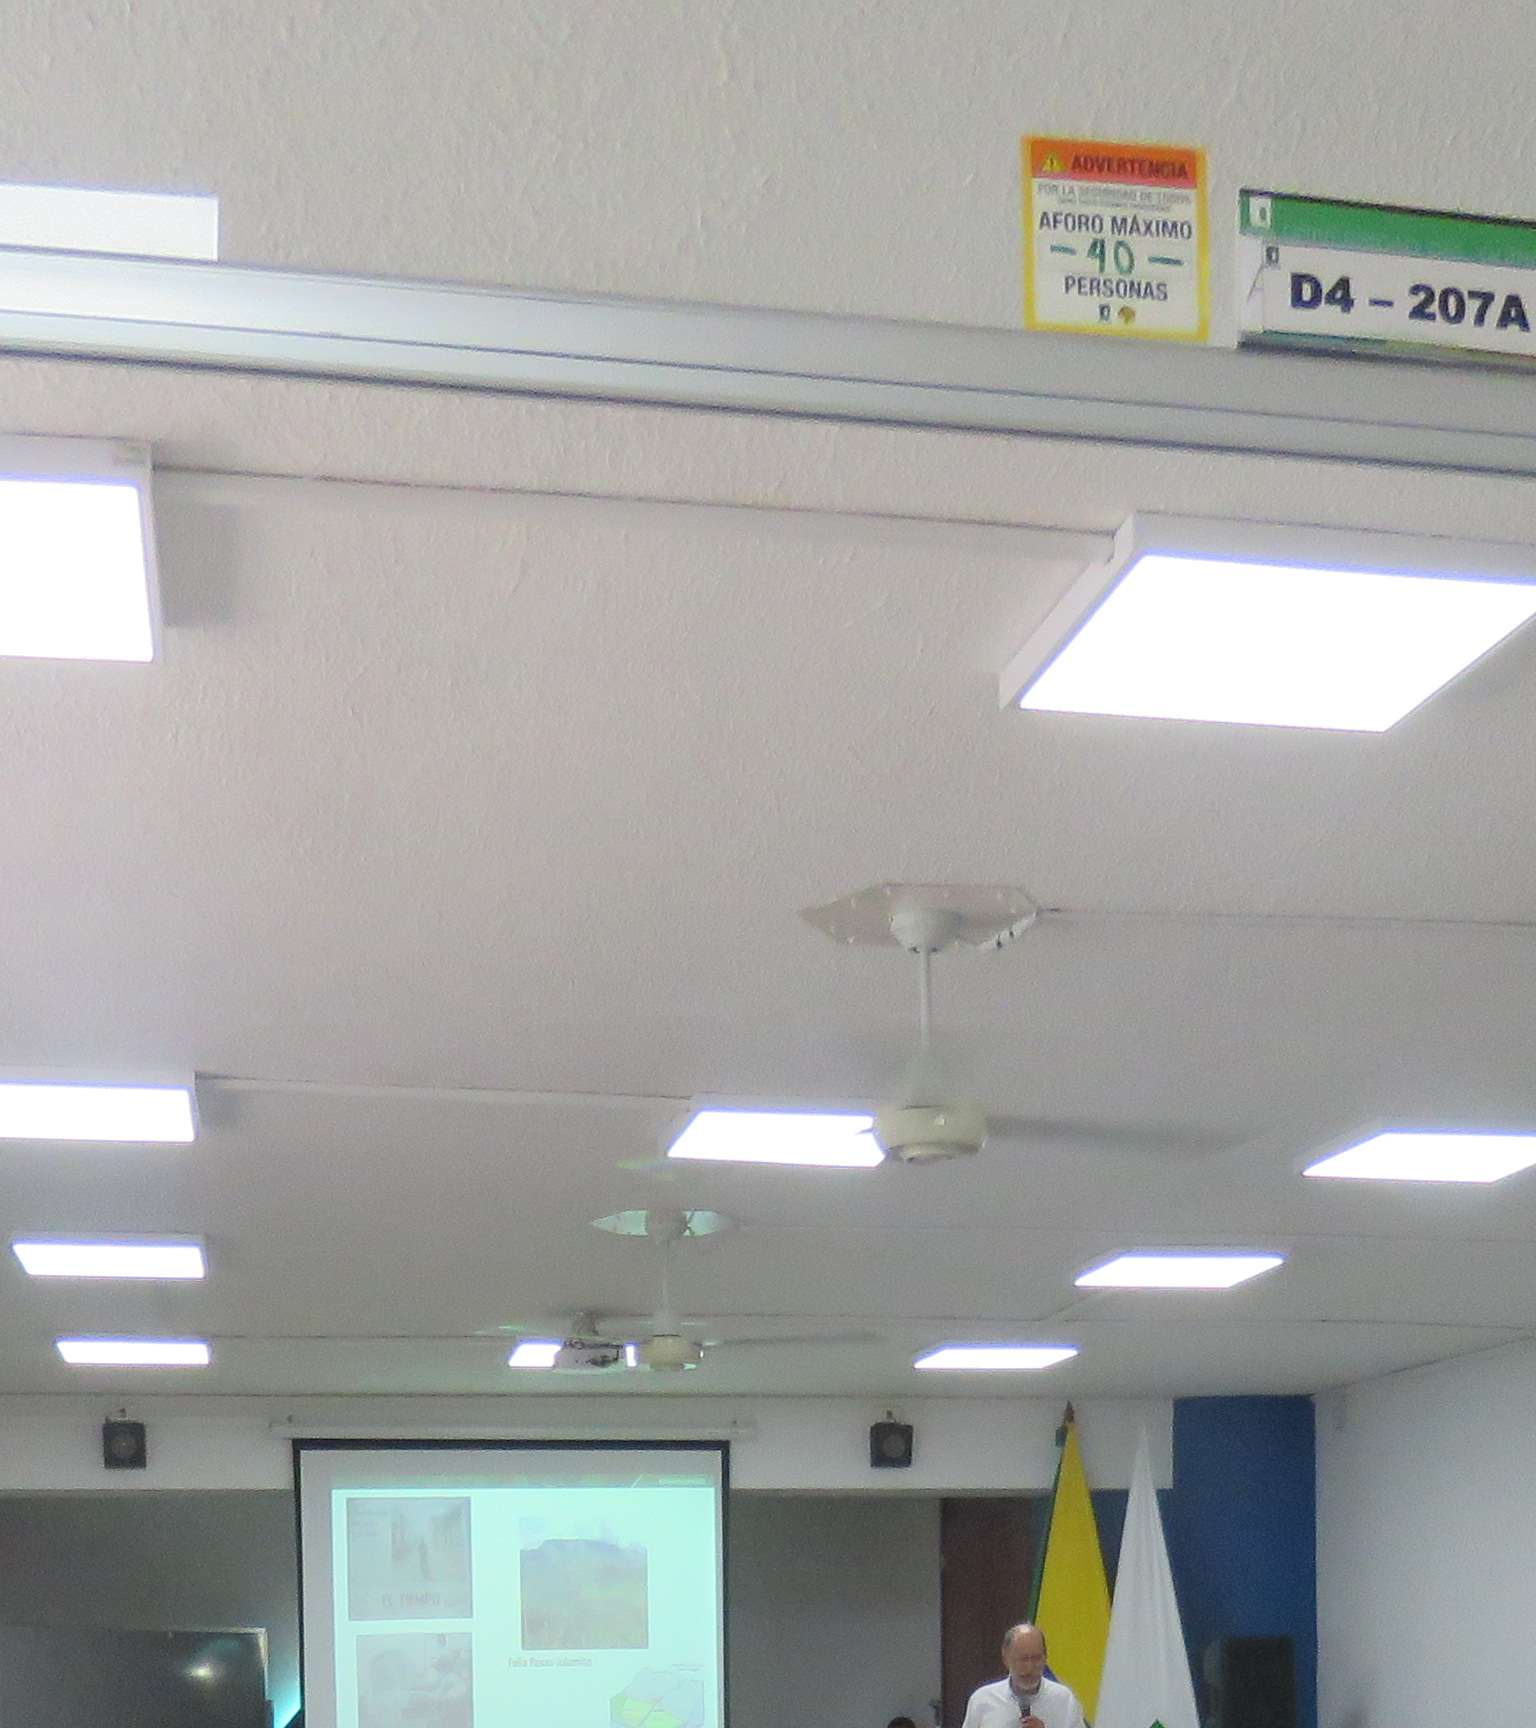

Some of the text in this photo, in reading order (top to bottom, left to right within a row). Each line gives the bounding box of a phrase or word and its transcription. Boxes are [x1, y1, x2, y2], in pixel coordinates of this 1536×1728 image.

[1071, 154, 1188, 179] ADVERTENCIA
[1039, 211, 1193, 240] AFORO MÁXIMO
[1064, 275, 1168, 301] PERSONAS
[1290, 272, 1356, 314] D4
[1408, 283, 1531, 334] 207A
